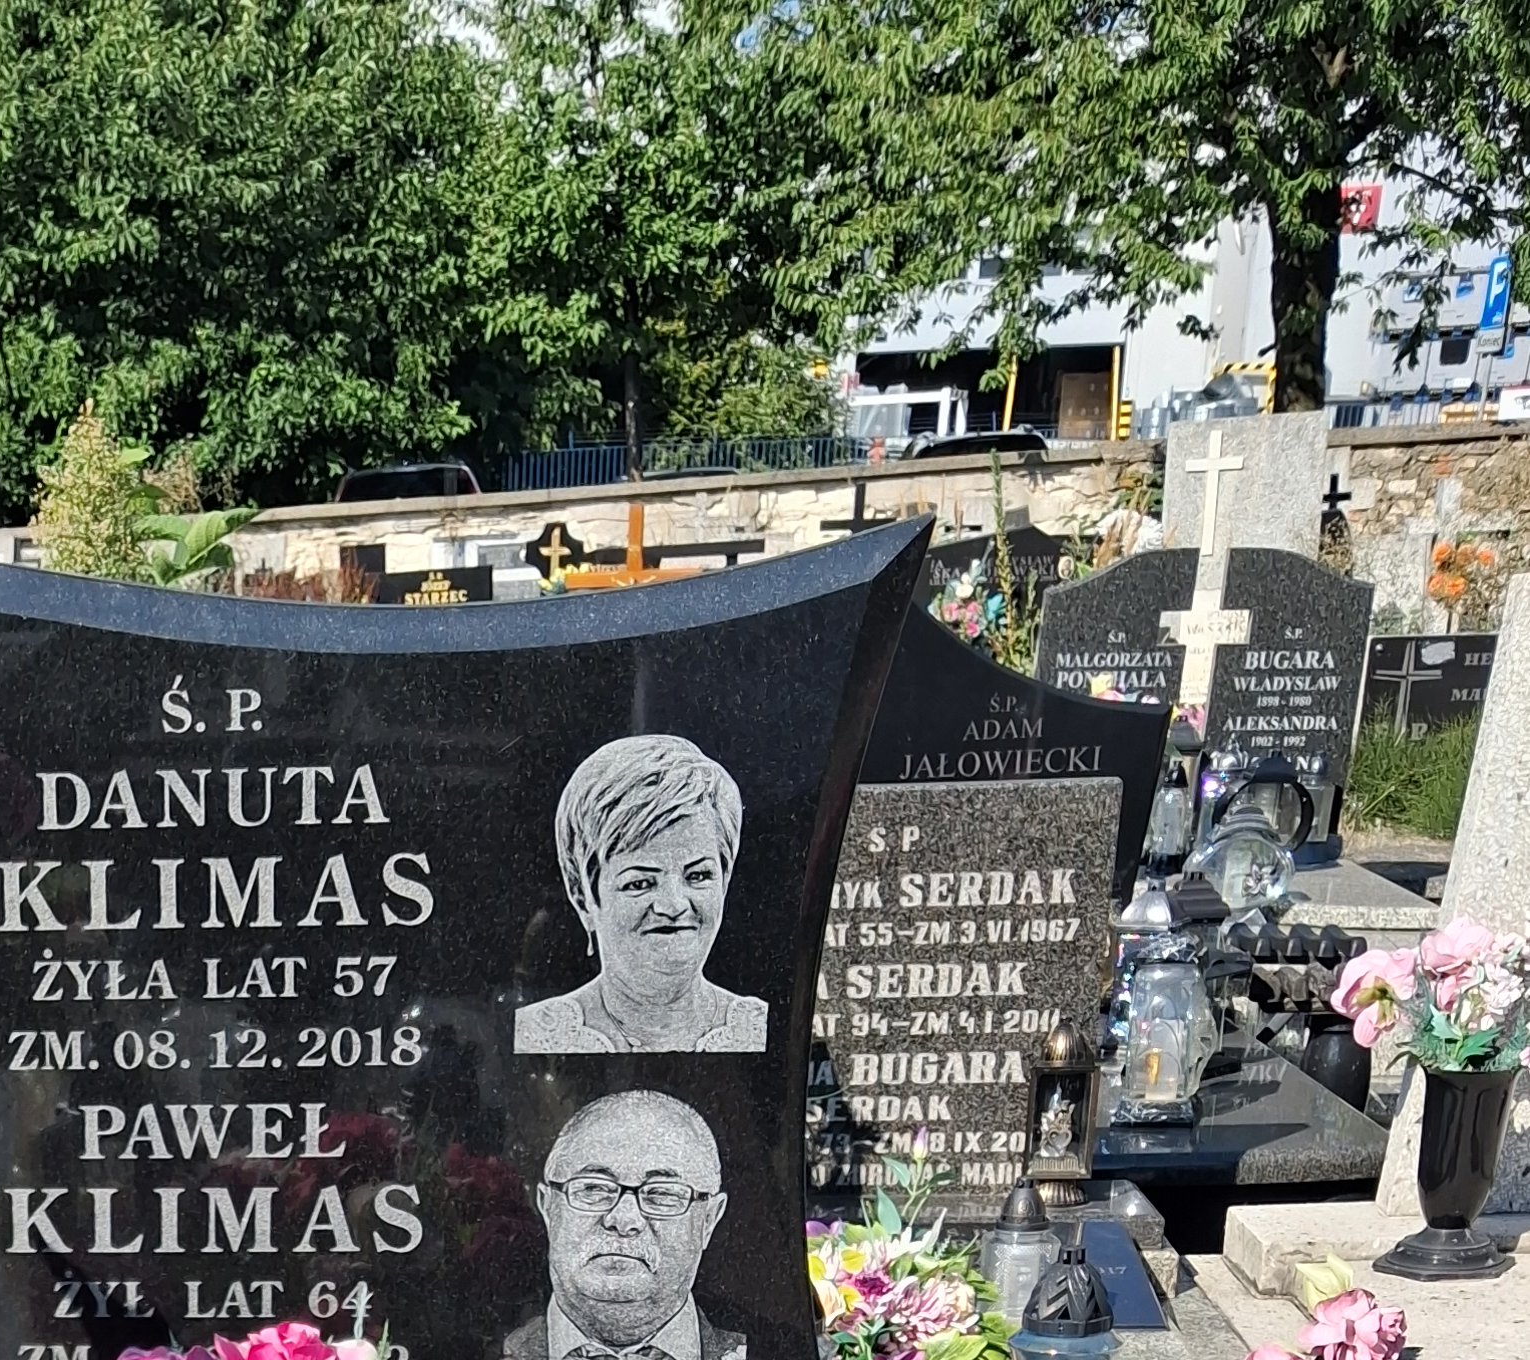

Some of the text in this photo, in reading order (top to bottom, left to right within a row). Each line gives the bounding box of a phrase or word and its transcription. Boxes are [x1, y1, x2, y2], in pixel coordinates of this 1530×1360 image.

[1477, 332, 1501, 346] Koniec
[404, 590, 468, 605] STARZEC
[1244, 650, 1335, 670] BUGARA
[161, 674, 264, 734] Ś. P.
[1223, 714, 1338, 731] ALEKSANDRA
[963, 717, 1044, 742] ADAM
[899, 744, 1102, 781] JAŁOWIECKI
[35, 763, 391, 831] DANUTA
[899, 868, 1078, 908] SERDAK
[32, 948, 398, 1002] ŻYŁA LAT 57
[845, 961, 1029, 1000] SERDAK
[7, 1025, 424, 1072] ZM. 08. 12. 2018
[849, 1050, 1027, 1086] BUGARA
[78, 1102, 348, 1161] PAWEŁ
[4, 1183, 425, 1255] KLIMAS
[53, 1270, 373, 1319] ŻYŁ LAT 64
